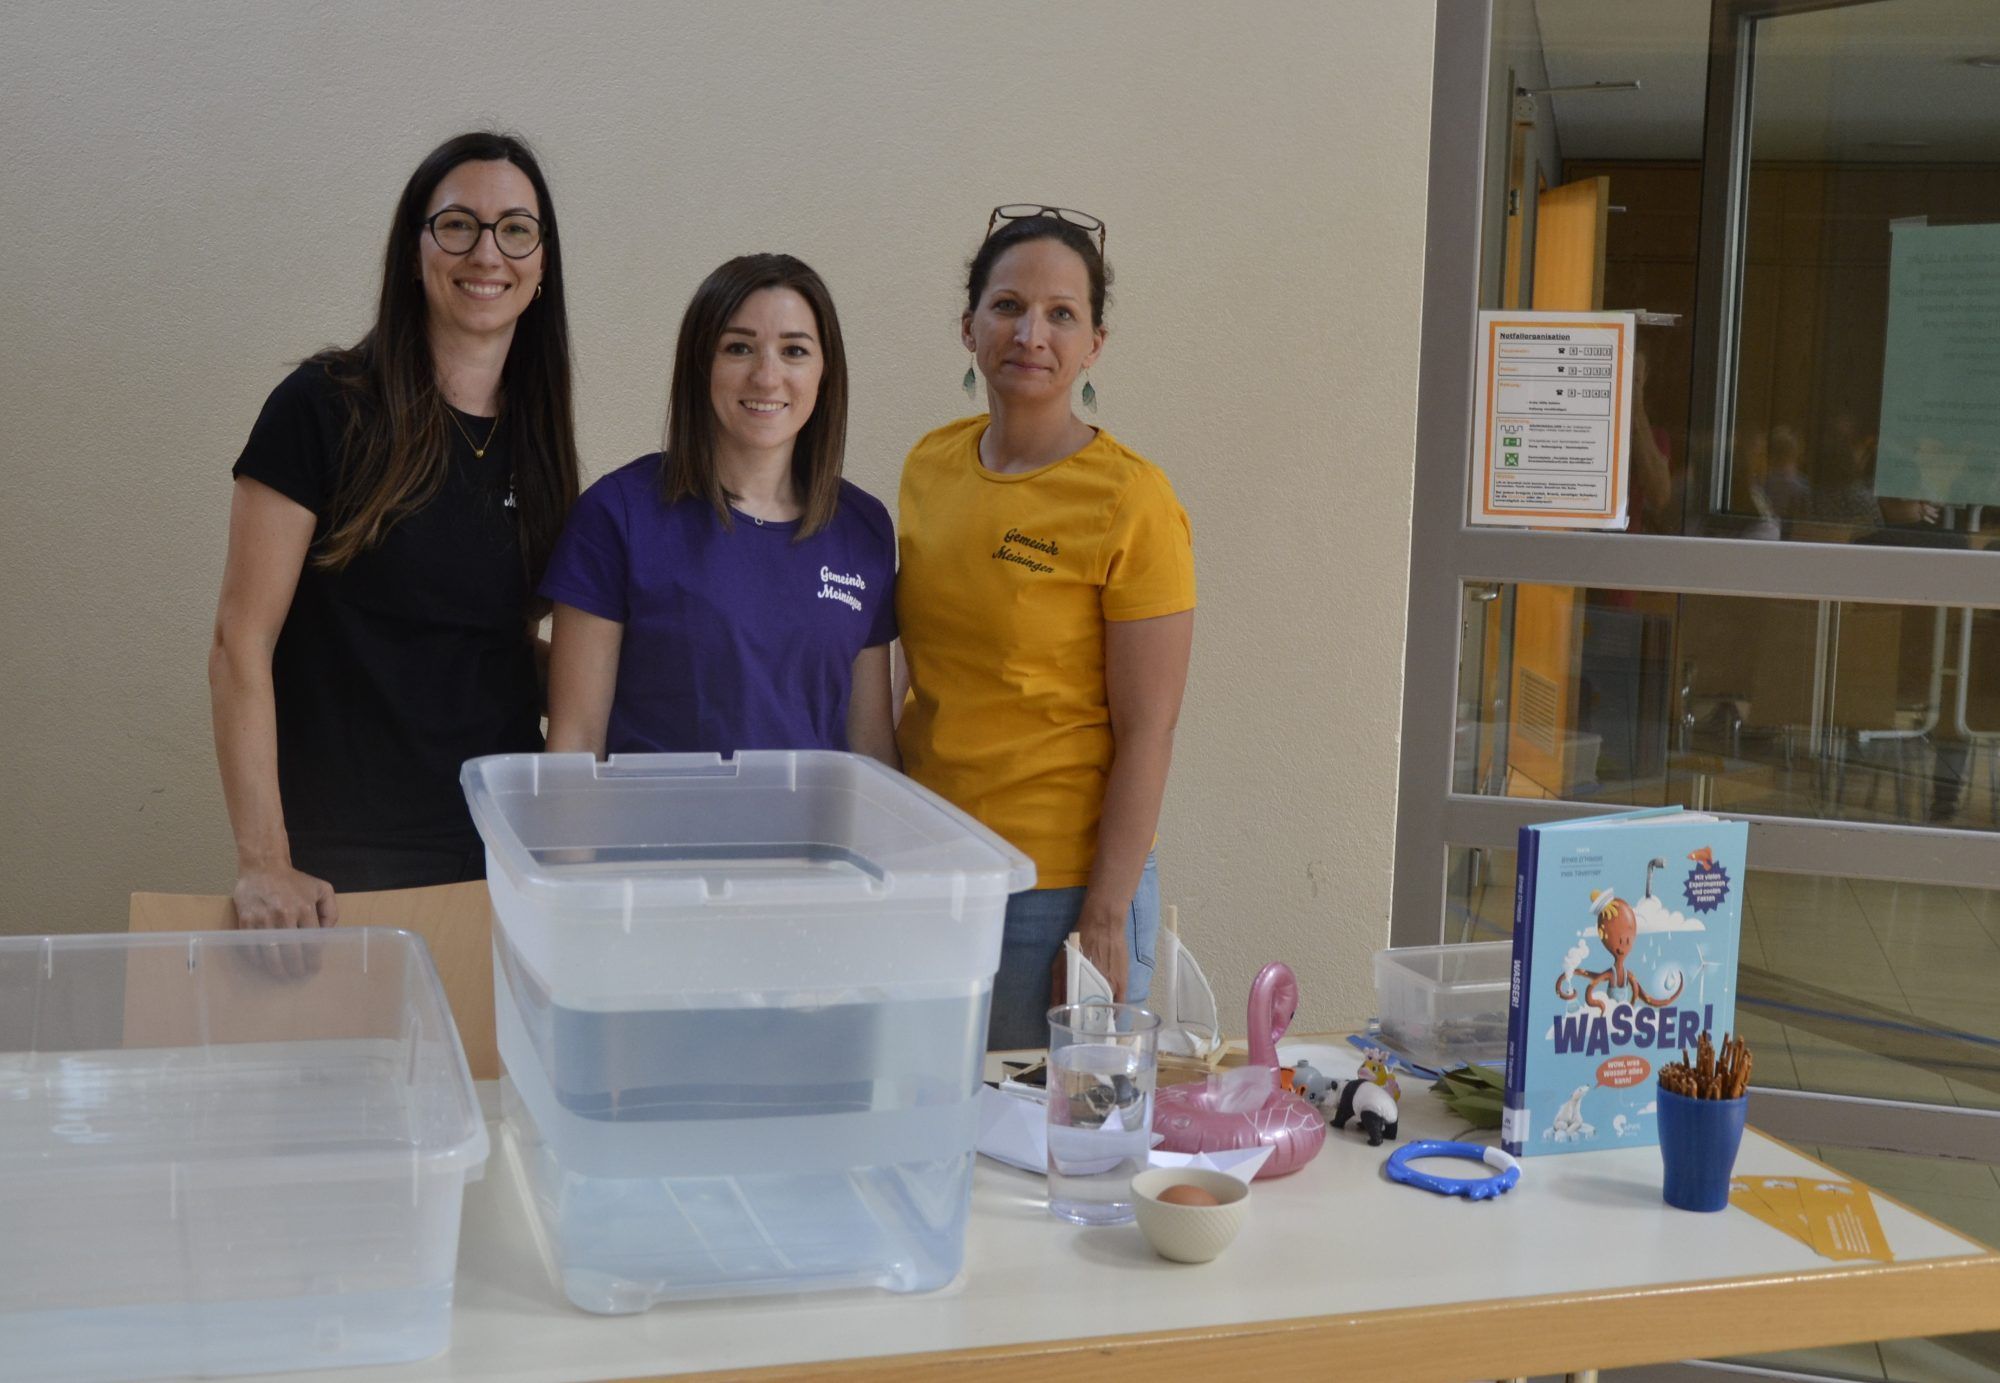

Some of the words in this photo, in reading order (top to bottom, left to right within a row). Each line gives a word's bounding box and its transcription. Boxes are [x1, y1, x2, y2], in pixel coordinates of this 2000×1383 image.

[1500, 332, 1571, 341] Notfallorganisation
[1003, 528, 1060, 556] Gemeinde
[992, 545, 1055, 574] Meiningen
[820, 566, 866, 590] Gemeinde
[817, 584, 863, 611] Meiningen
[1689, 880, 1726, 888] Experimenten
[1511, 959, 1522, 1008] WASSER!
[1553, 1003, 1714, 1056] WASSER!
